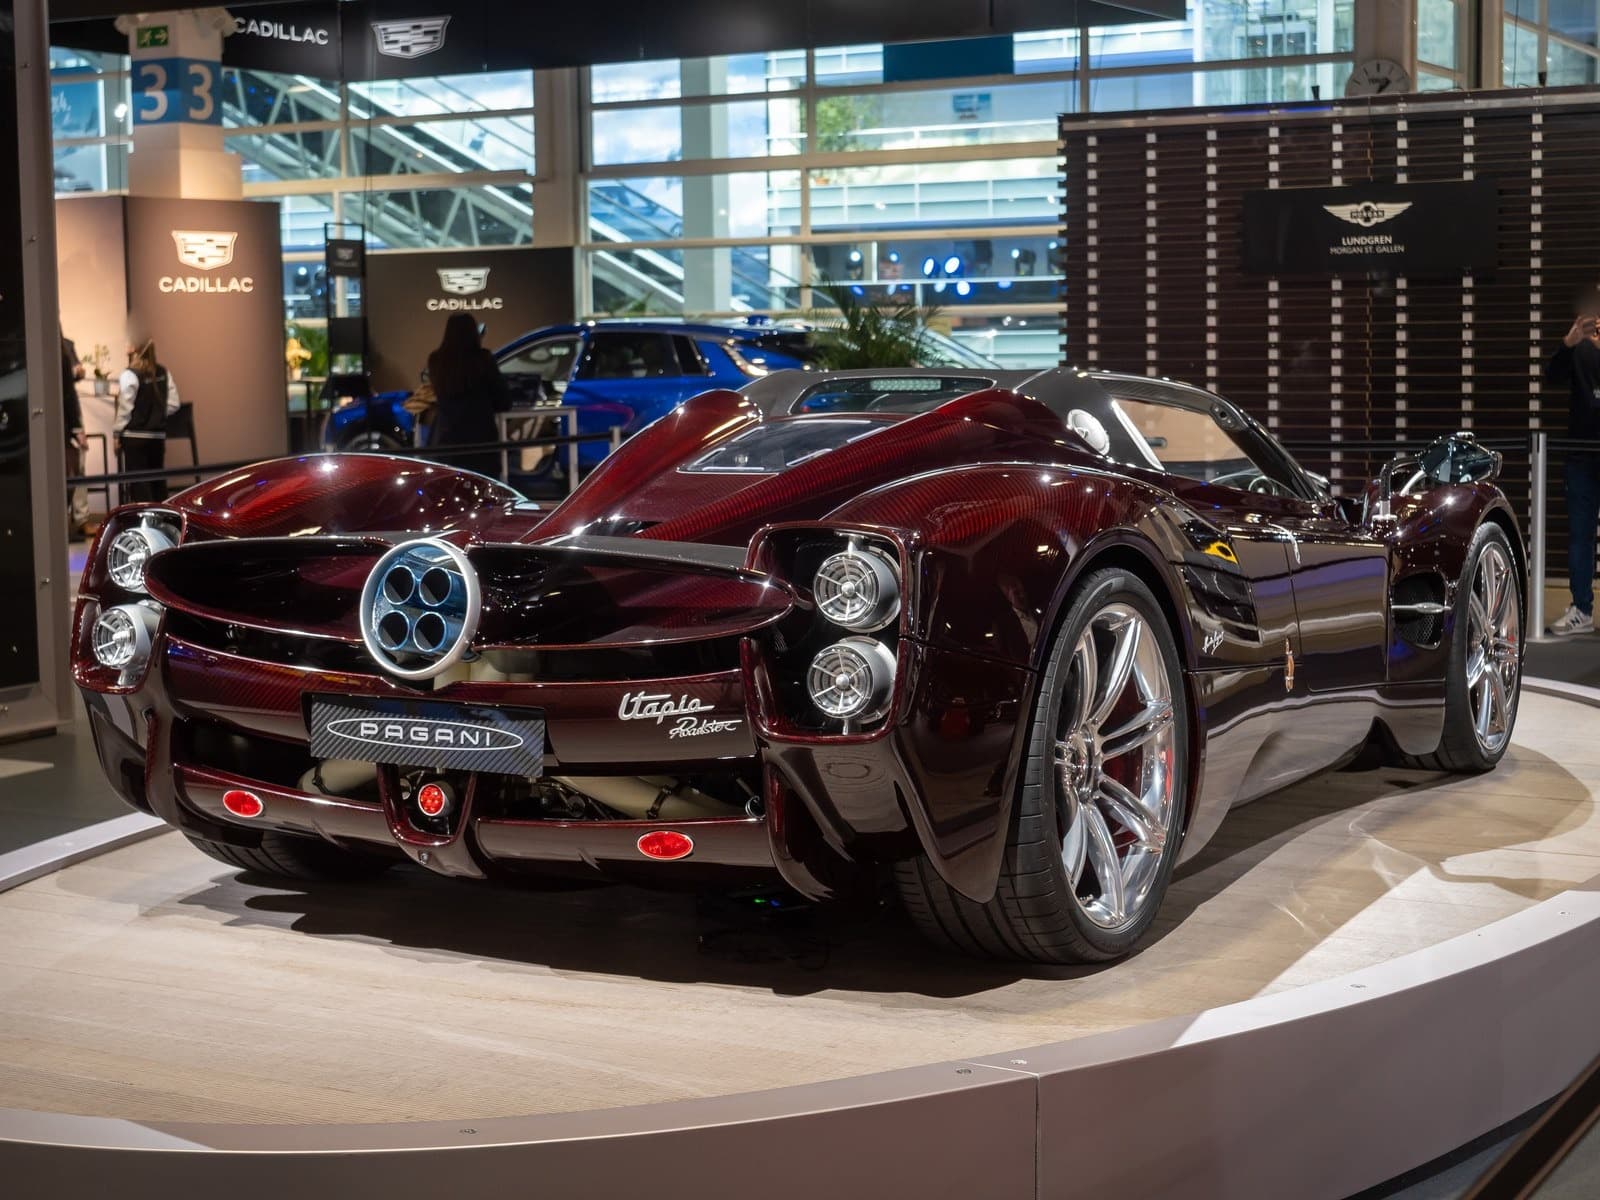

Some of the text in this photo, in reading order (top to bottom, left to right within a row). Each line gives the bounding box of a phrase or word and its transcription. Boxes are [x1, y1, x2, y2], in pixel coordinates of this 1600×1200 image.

[234, 17, 328, 45] CADILLAC
[140, 64, 168, 121] 3
[188, 64, 214, 120] 3
[1329, 246, 1363, 255] MORGAN
[1375, 244, 1405, 253] GALLEN
[1341, 235, 1392, 246] LUNDGREN
[158, 276, 254, 293] CADILLAC
[426, 297, 503, 311] CADILLAC
[360, 722, 491, 746] PAGANI
